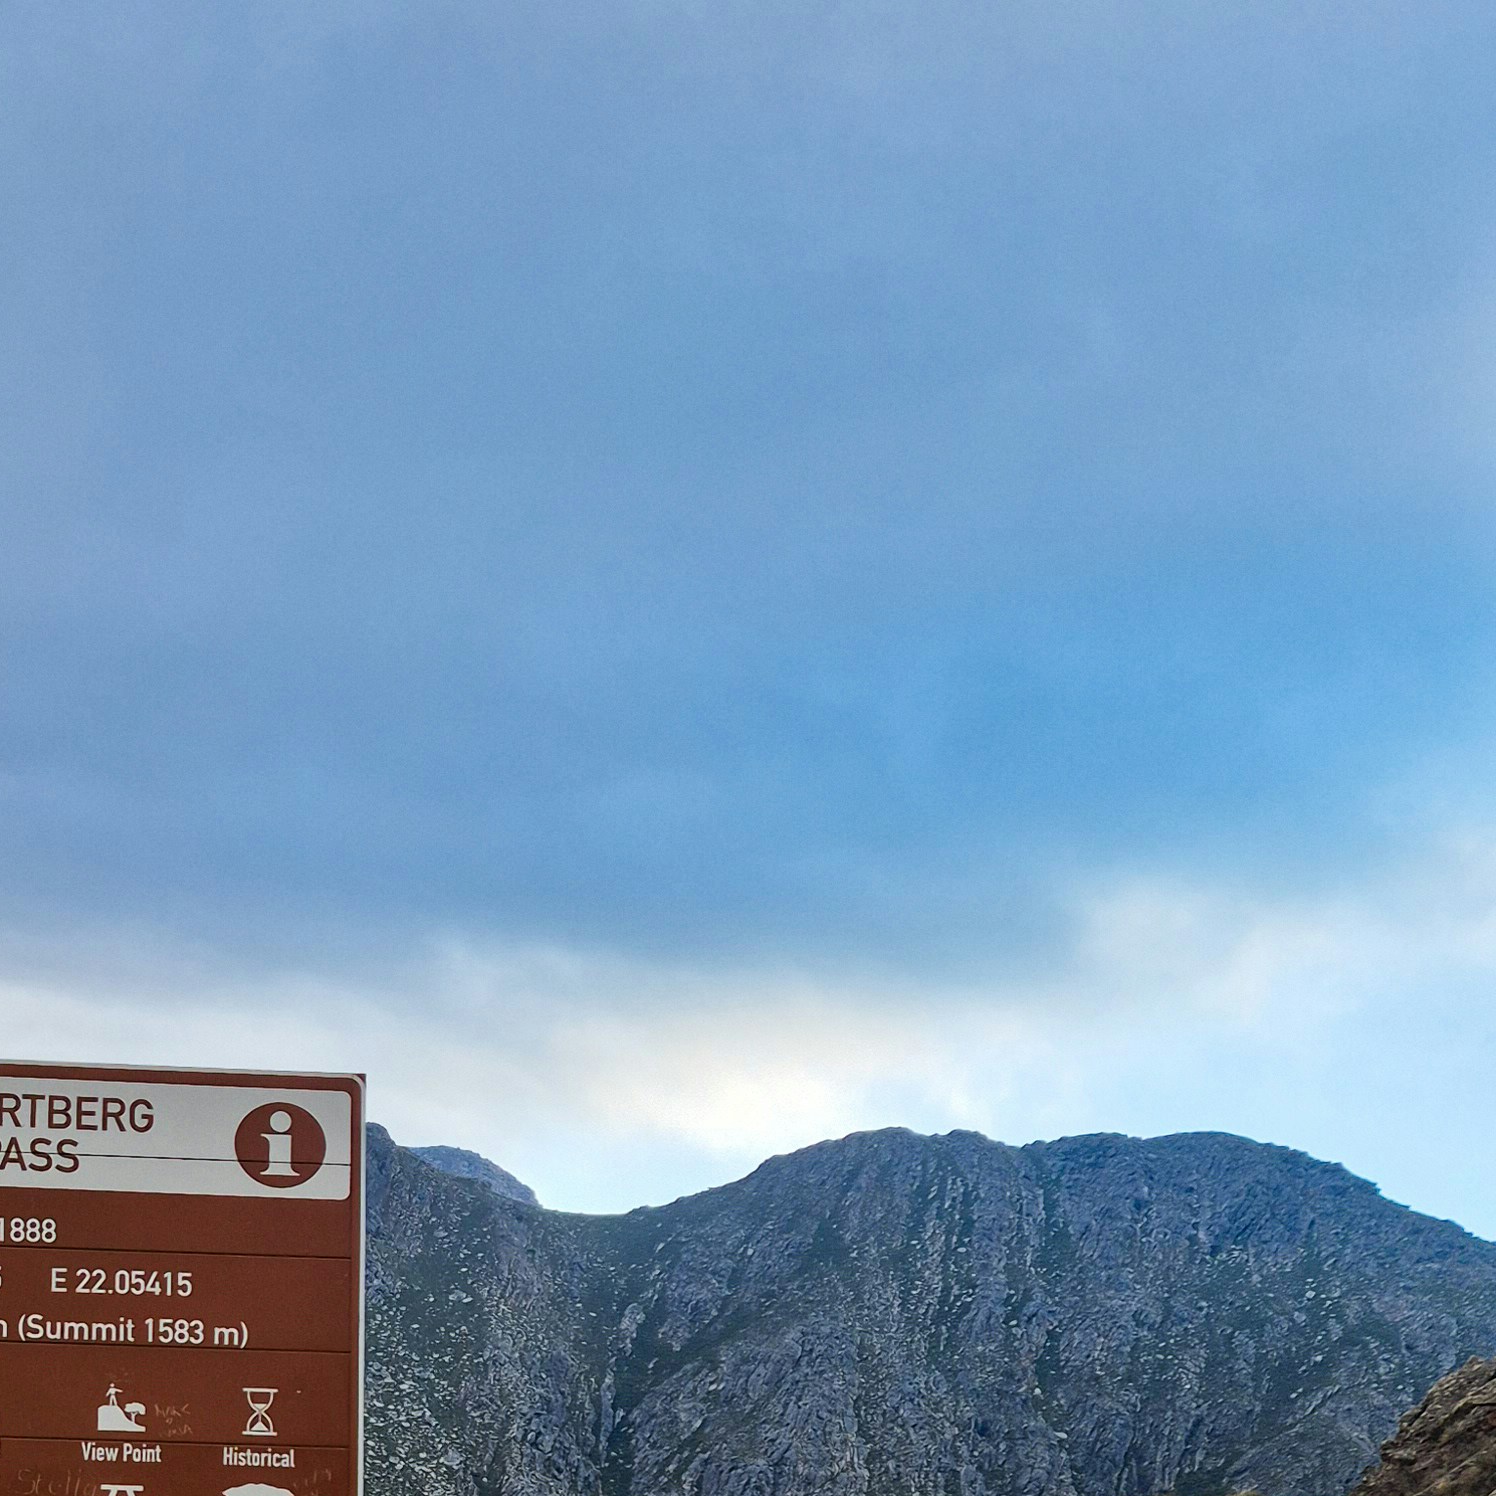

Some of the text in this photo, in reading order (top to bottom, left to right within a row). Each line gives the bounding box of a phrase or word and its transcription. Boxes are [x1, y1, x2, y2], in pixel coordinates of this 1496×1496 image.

[51, 1267, 68, 1293] E
[75, 1268, 192, 1297] 22.05415
[18, 1313, 135, 1342] (Summit
[144, 1317, 204, 1345] 1583
[213, 1321, 248, 1349] m)
[81, 1442, 161, 1463] View Point
[223, 1446, 295, 1468] Historical
